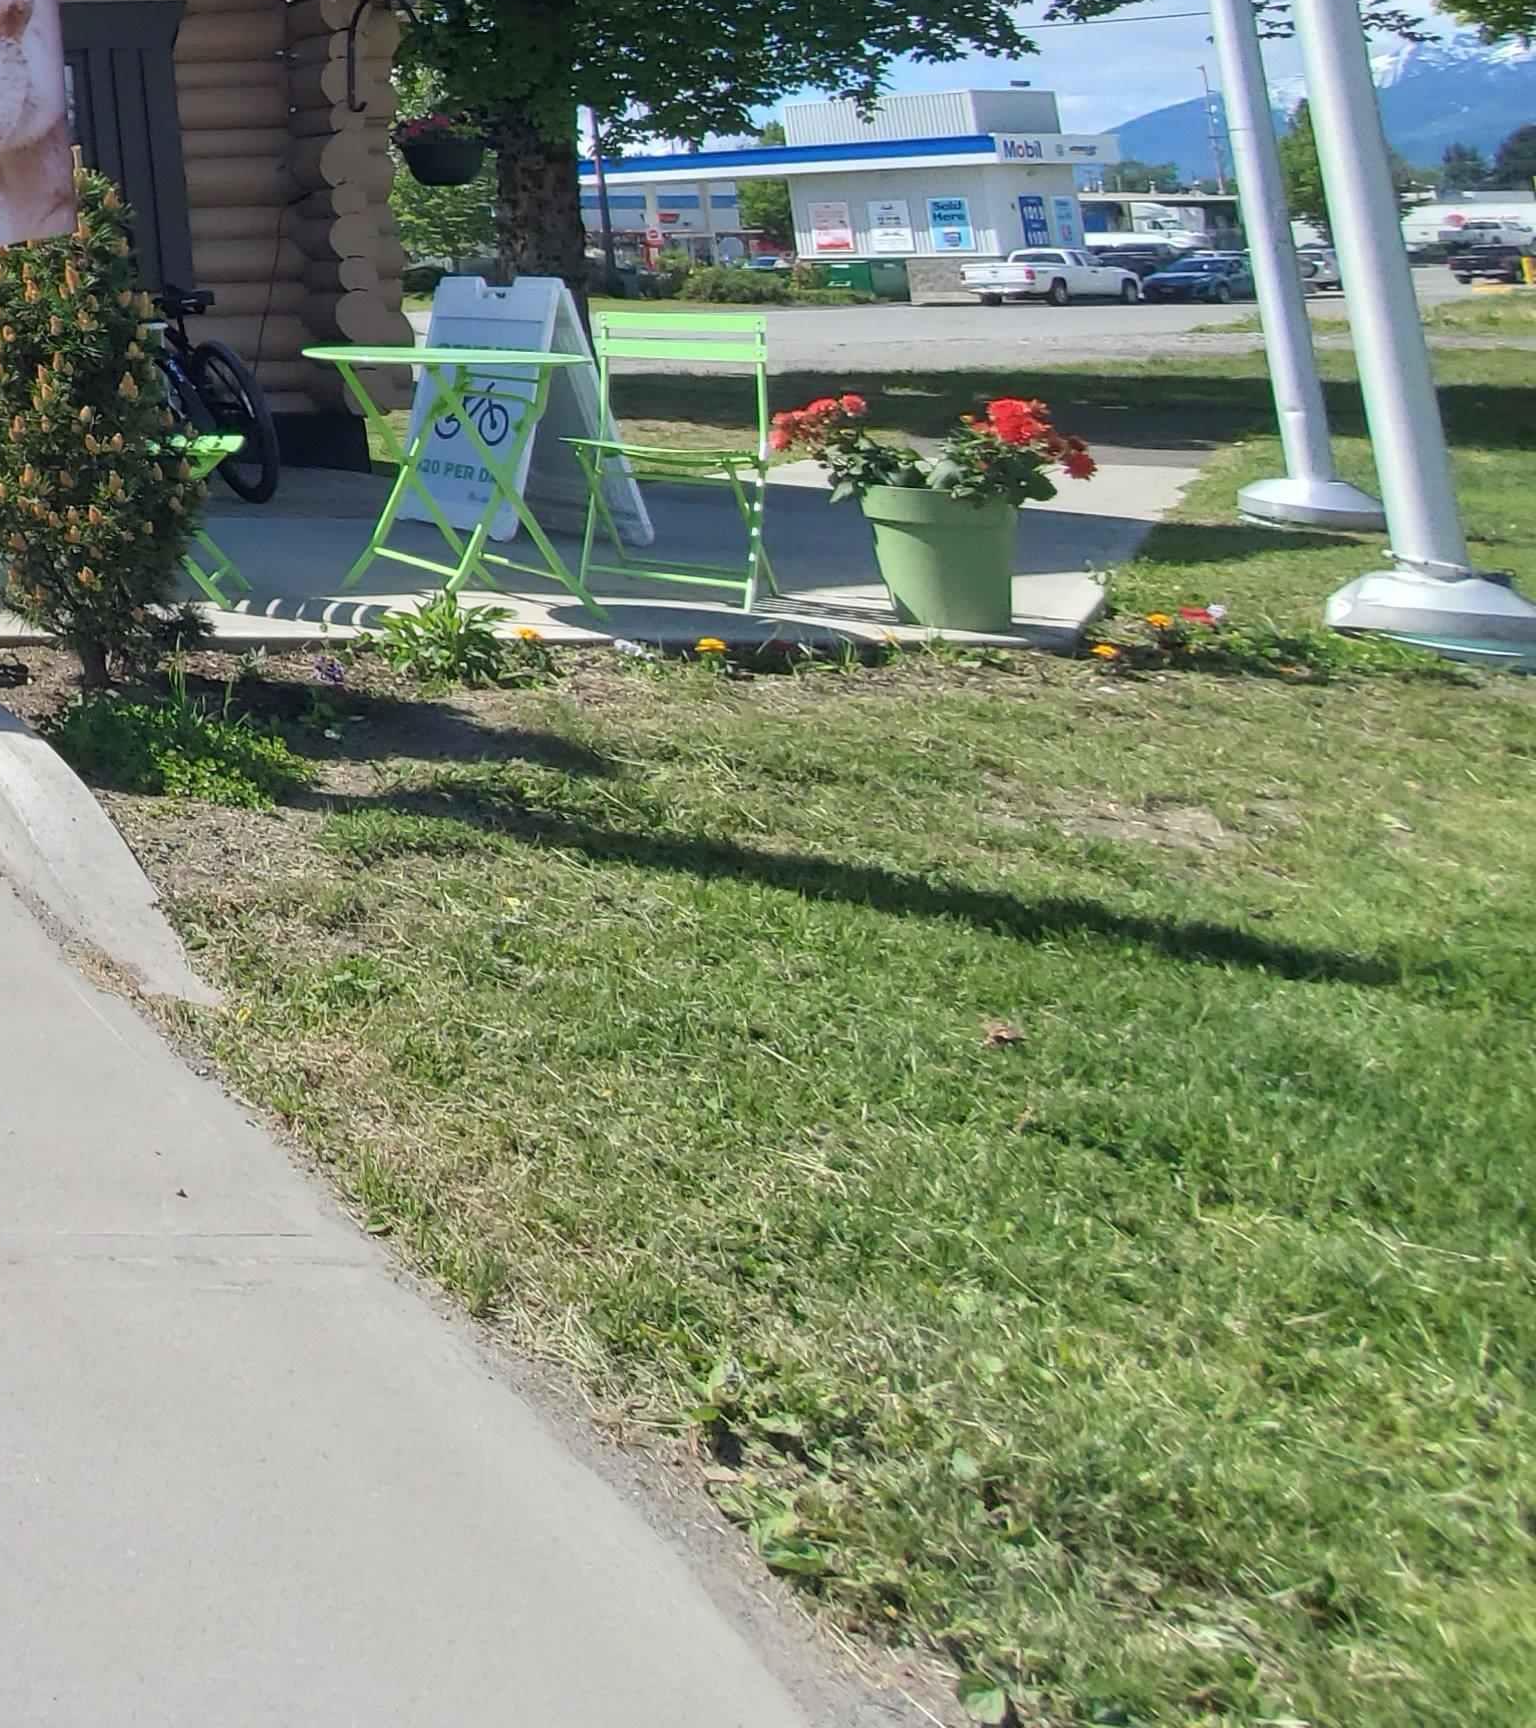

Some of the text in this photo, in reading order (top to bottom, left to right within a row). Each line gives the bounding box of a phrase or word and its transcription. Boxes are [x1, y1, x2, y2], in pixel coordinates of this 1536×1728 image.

[1002, 139, 1043, 159] Mobil
[931, 199, 964, 212] Sold
[932, 211, 967, 223] Here
[442, 462, 475, 482] PER
